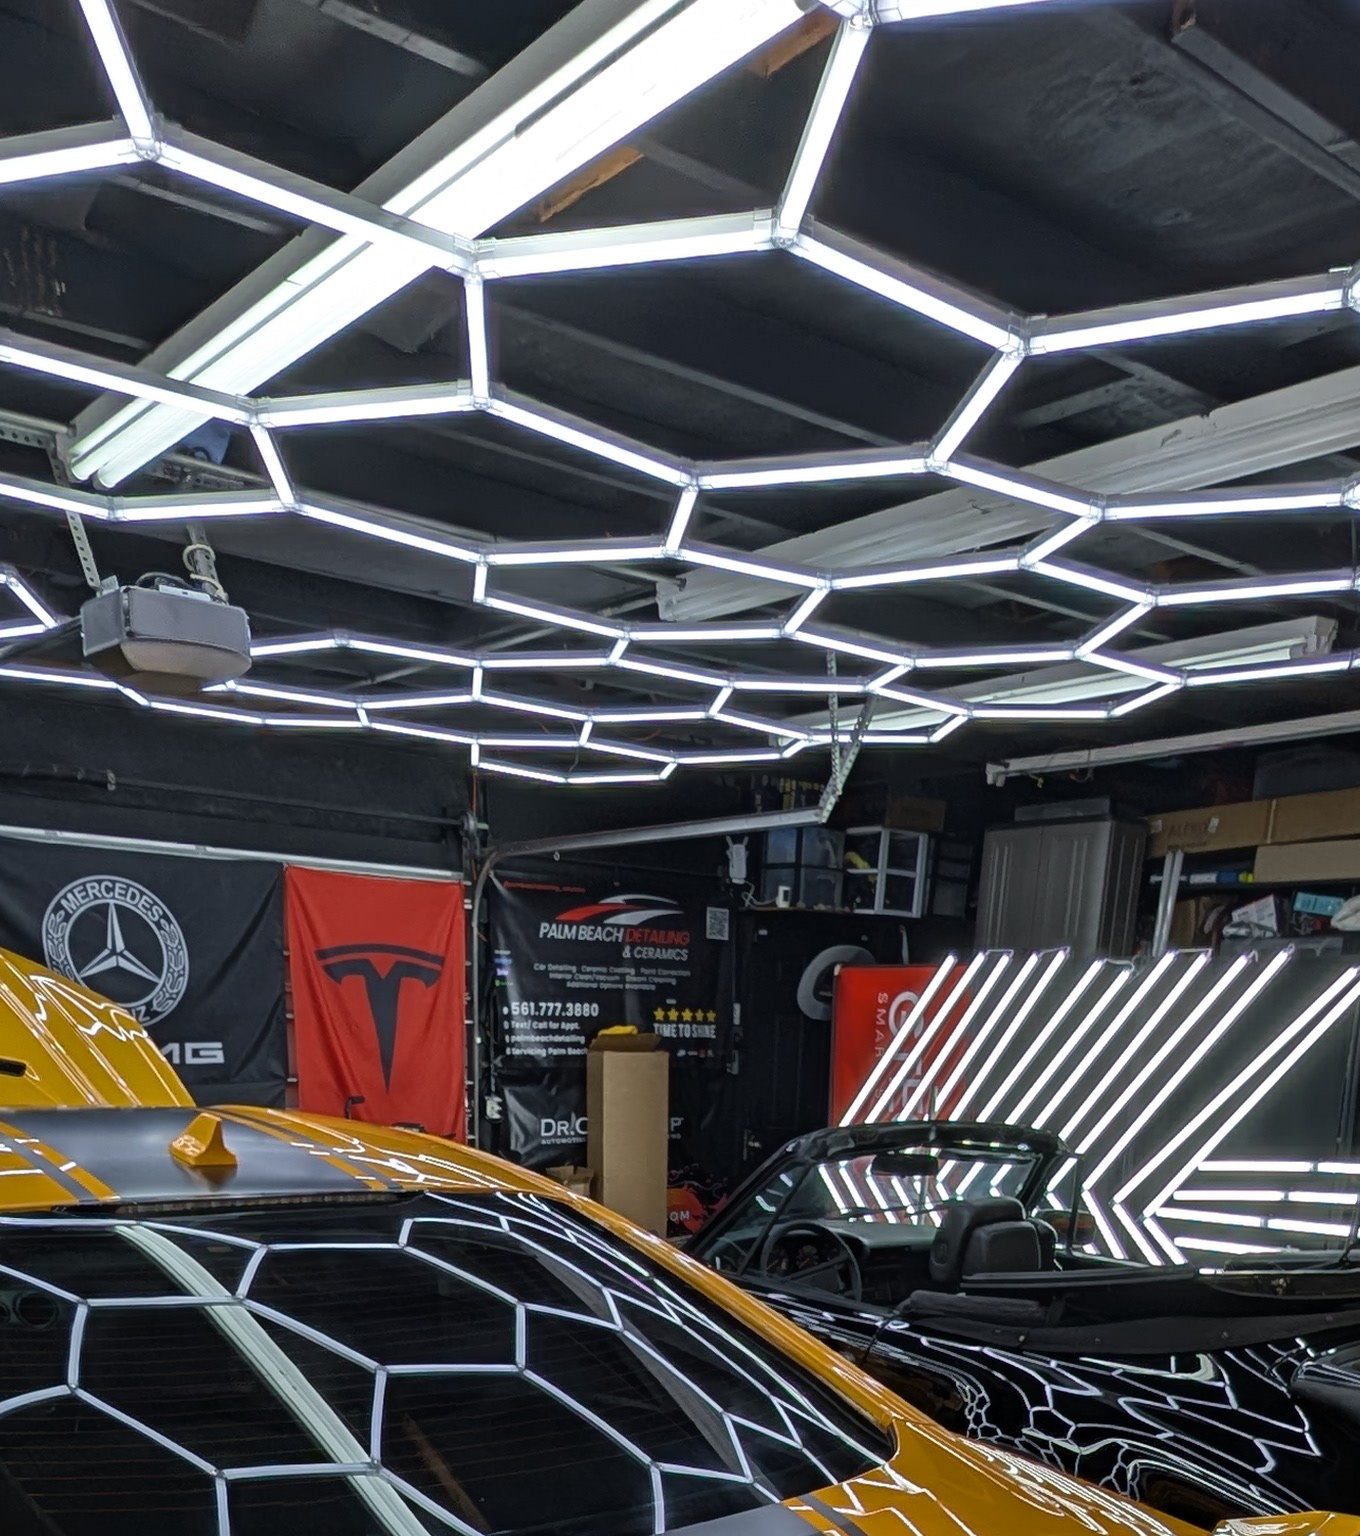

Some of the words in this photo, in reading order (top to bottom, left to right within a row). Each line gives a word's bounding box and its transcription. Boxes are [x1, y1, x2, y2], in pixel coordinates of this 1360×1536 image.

[59, 880, 164, 923] MERCEDES
[538, 922, 577, 940] PALM
[577, 923, 625, 943] BEACH
[633, 946, 688, 961] CERAMICS
[510, 1001, 600, 1018] 561.777.3880
[653, 1023, 677, 1038] TIME
[677, 1024, 691, 1038] TO
[691, 1024, 717, 1039] SHINE
[874, 992, 889, 1058] SMAR
